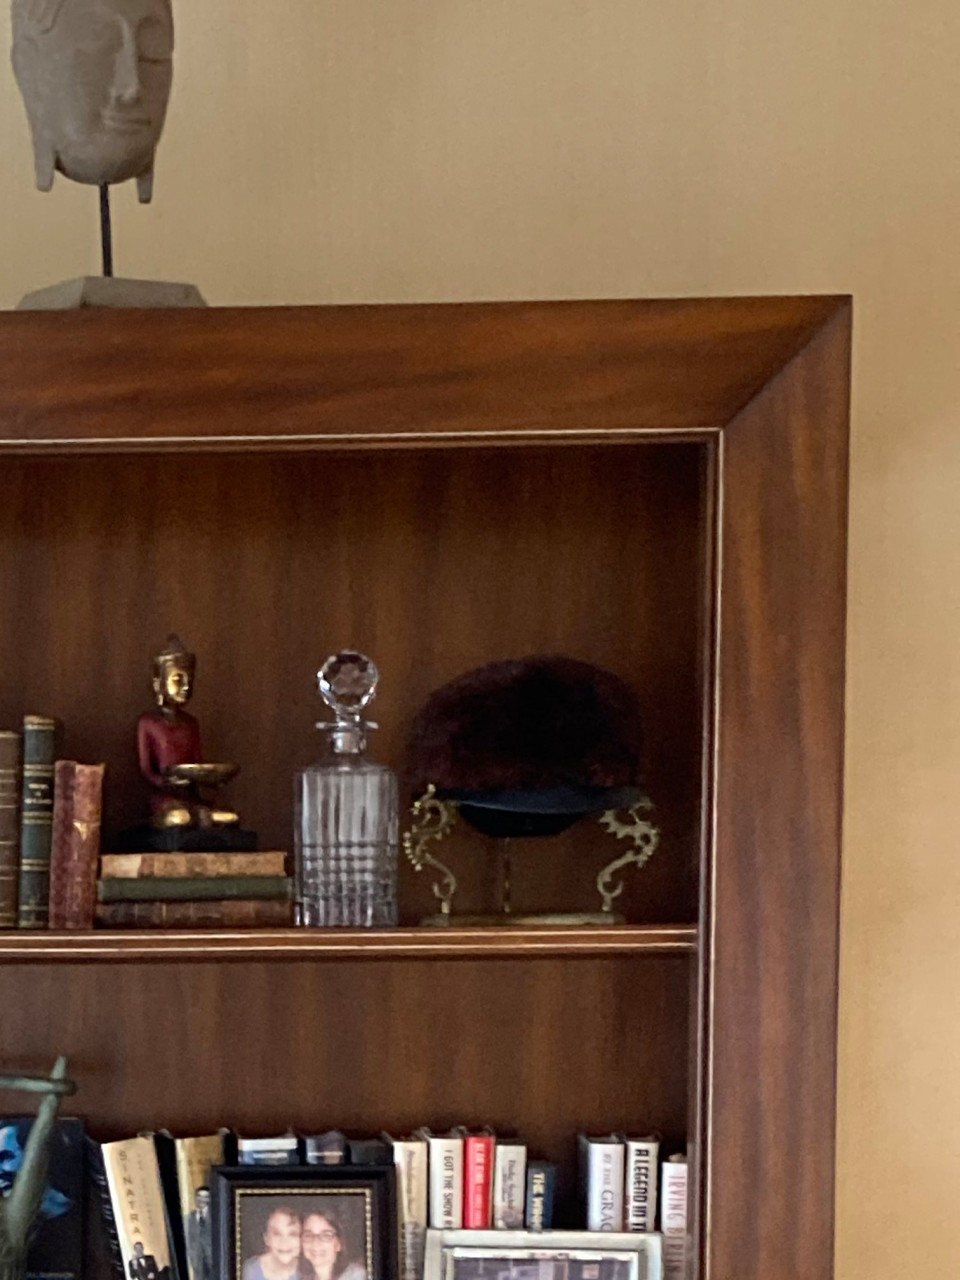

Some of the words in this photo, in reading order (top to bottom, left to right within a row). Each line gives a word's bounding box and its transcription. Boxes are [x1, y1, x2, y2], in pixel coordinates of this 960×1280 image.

[443, 1155, 454, 1171] GOT
[634, 1148, 648, 1156] A
[443, 1174, 454, 1190] THE
[533, 1173, 545, 1194] THE
[603, 1168, 612, 1187] THE
[633, 1159, 648, 1203] LEGEND
[118, 1149, 142, 1235] SINATRA
[443, 1192, 454, 1217] SHOW
[667, 1175, 685, 1220] IRVING
[601, 1189, 615, 1231] GRAC
[666, 1227, 684, 1273] BERLIN
